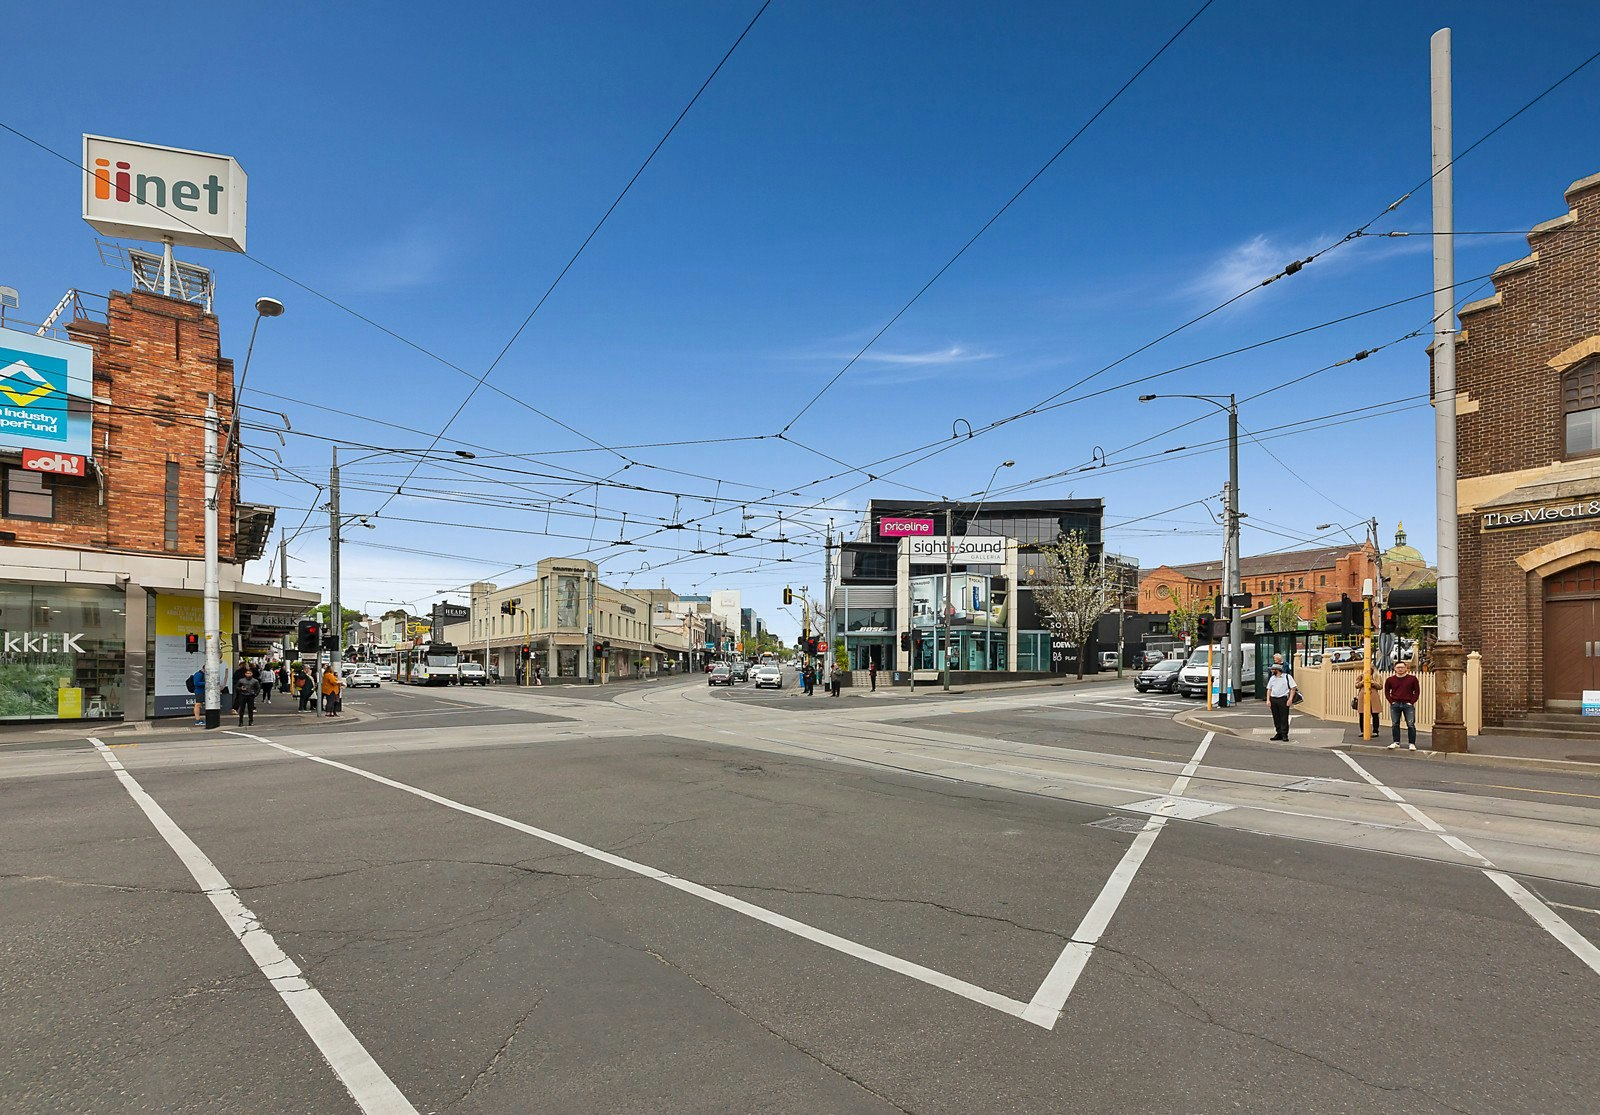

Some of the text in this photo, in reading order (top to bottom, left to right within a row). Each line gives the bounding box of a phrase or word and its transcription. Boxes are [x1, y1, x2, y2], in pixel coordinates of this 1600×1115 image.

[95, 158, 224, 215] iinet
[5, 408, 57, 424] Industry
[1588, 501, 1600, 514] &
[885, 522, 929, 533] priceline
[959, 540, 1001, 553] sound
[263, 616, 298, 625] kikki.K
[4, 632, 87, 653] kki.K
